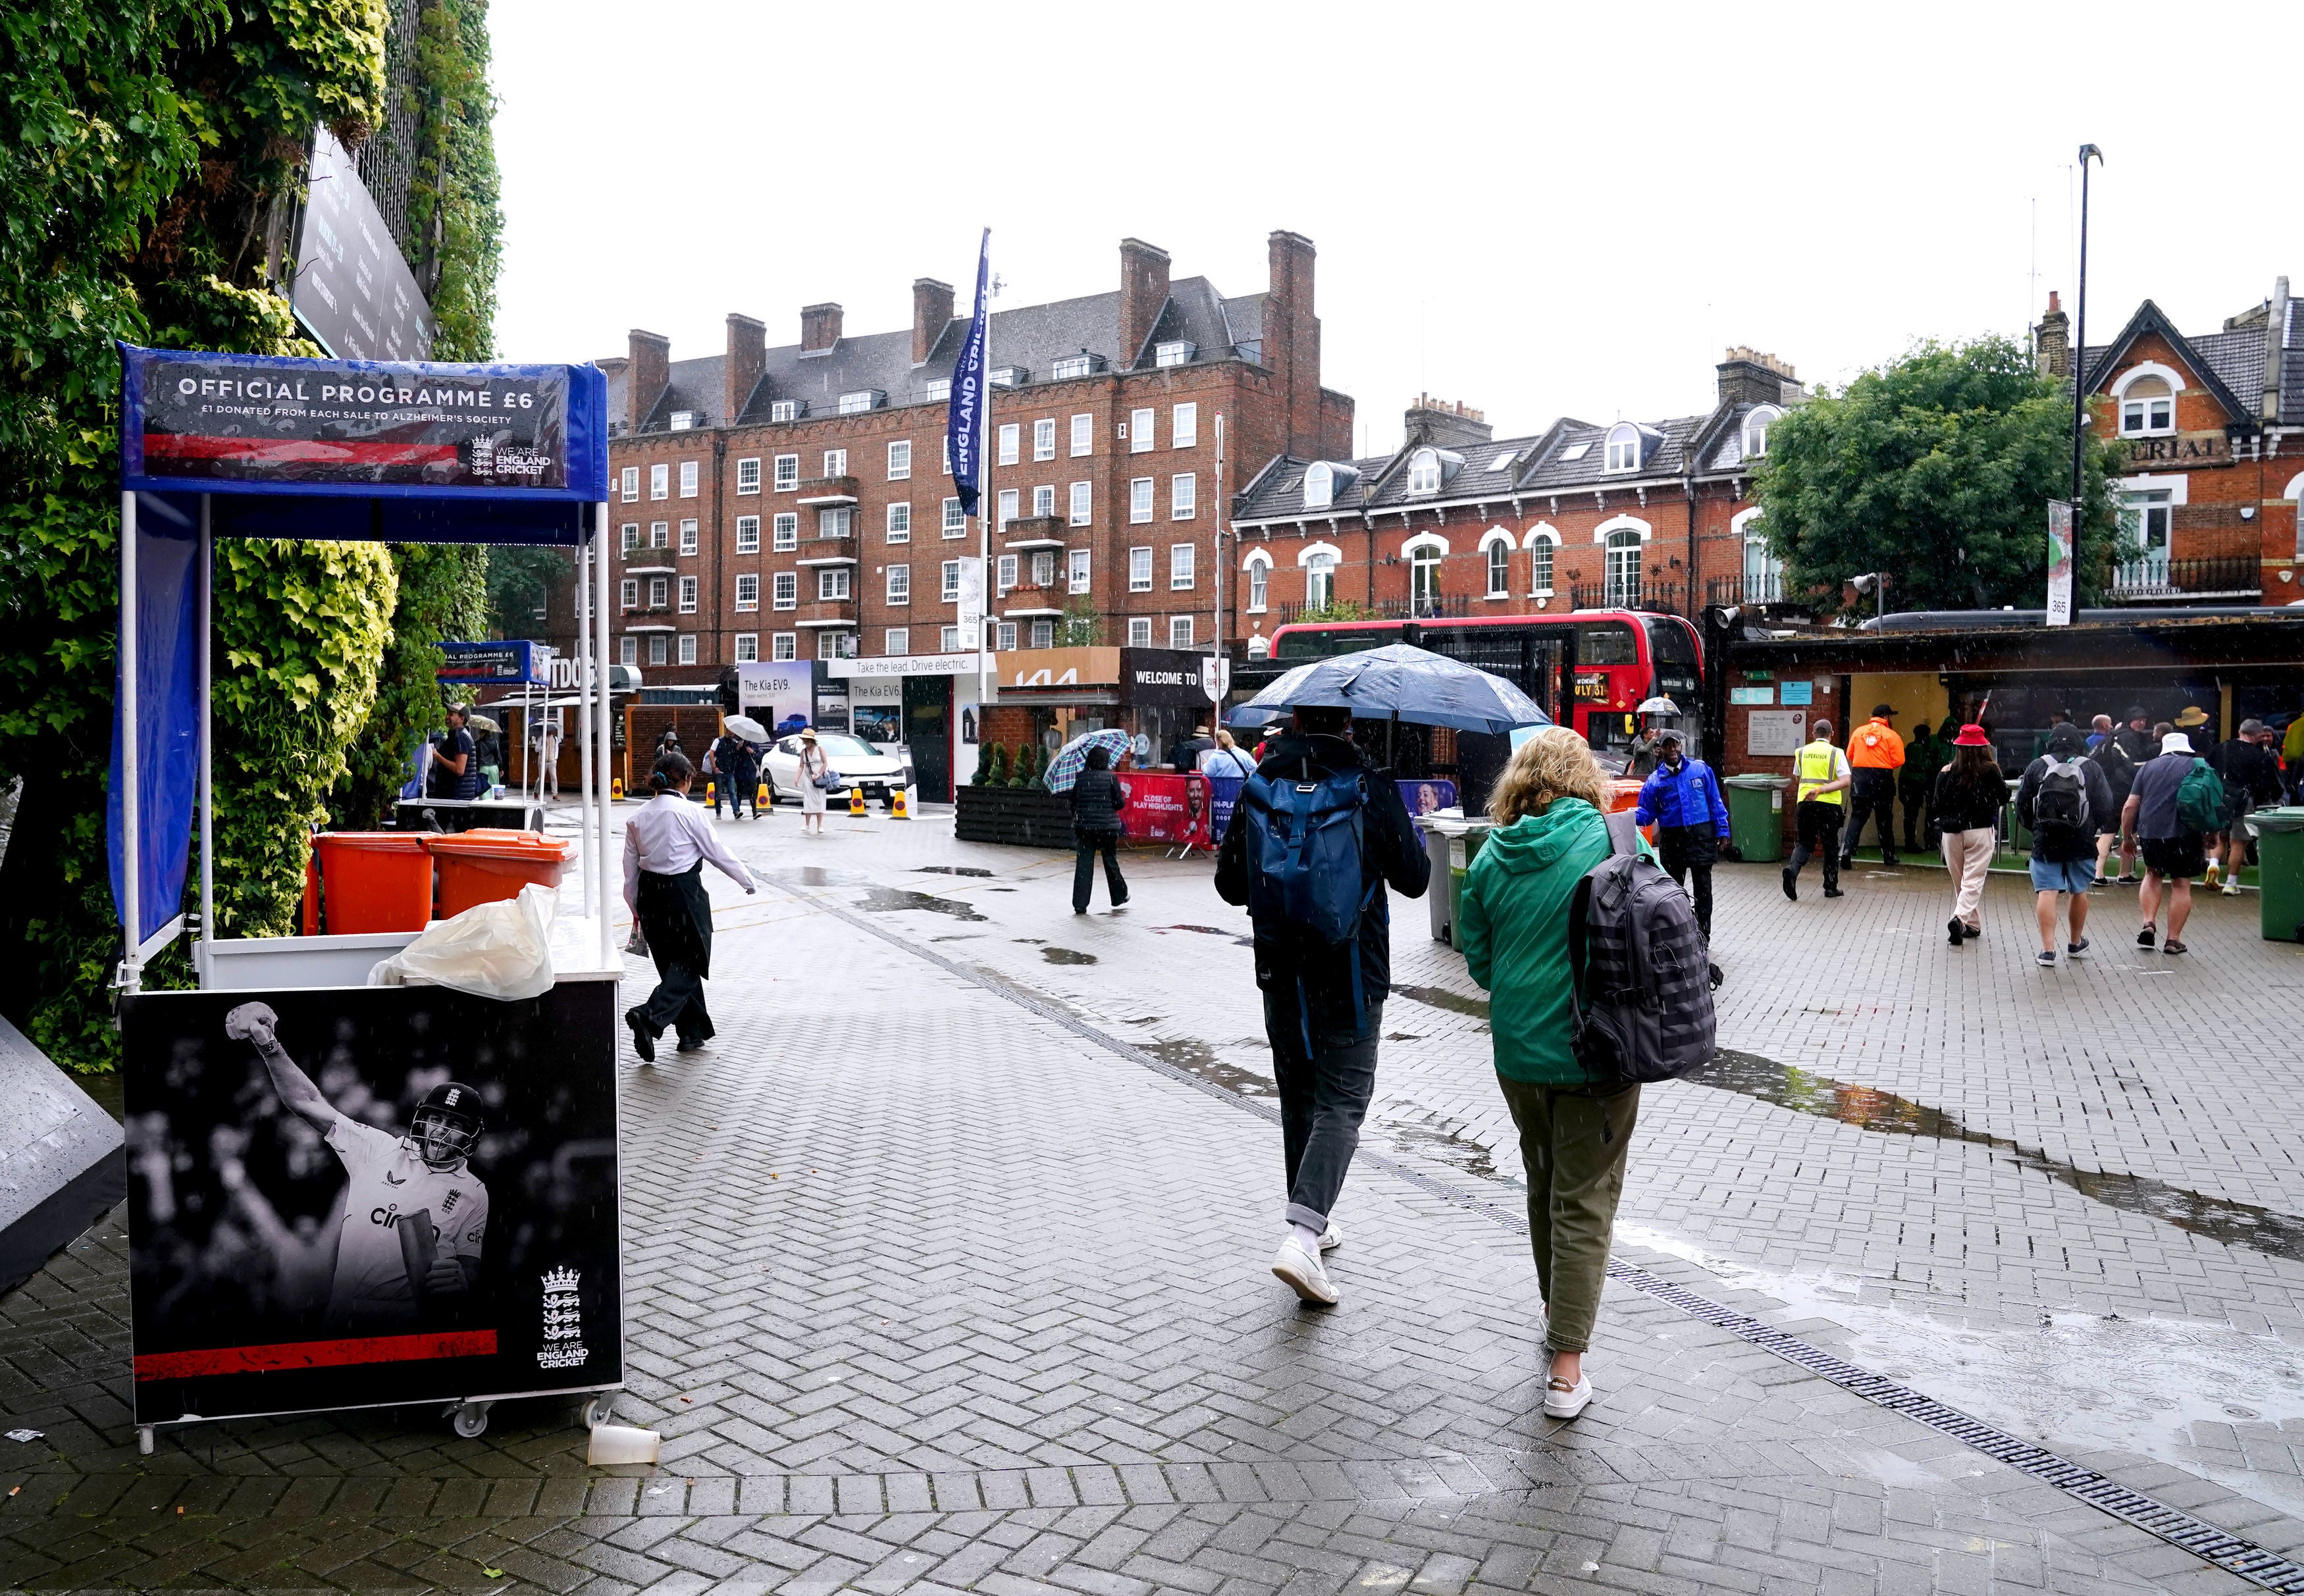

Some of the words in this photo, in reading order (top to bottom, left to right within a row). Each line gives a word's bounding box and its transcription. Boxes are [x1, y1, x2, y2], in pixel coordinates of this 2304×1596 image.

[178, 378, 309, 401] OFFICIAL
[322, 385, 492, 407] PROGRAMME
[503, 392, 533, 409] £6
[217, 405, 271, 415] DONATED
[275, 408, 307, 417] FROM
[310, 410, 340, 419] EACH
[392, 413, 463, 423] ALZHEIMER'S
[466, 415, 511, 425] SOCIETY
[958, 376, 976, 475] ENGLAND
[496, 447, 514, 455] WE
[517, 448, 539, 456] ARE
[496, 455, 551, 466] ENGLAND
[496, 465, 544, 475] CRICKET
[2052, 600, 2066, 613] 365
[963, 615, 978, 624] 365
[550, 647, 560, 657] OG!
[856, 662, 874, 673] Take
[876, 662, 889, 673] the
[891, 661, 910, 672] lead.
[912, 659, 933, 671] Drive
[935, 657, 968, 670] electric.
[1136, 670, 1182, 686] WELCOME
[1184, 673, 1197, 686] TO
[1206, 678, 1226, 686] SUREY
[745, 680, 758, 691] The
[760, 679, 772, 690] Kia
[773, 679, 791, 690] EV9.
[854, 686, 868, 697] The
[870, 686, 881, 697] Kia
[884, 685, 901, 696] EV6.
[1575, 684, 1591, 696] ULY
[1594, 684, 1604, 696] 31
[1148, 802, 1183, 811] HIGHLIGHTS
[542, 1343, 560, 1352] WE
[562, 1341, 583, 1351] ARE
[537, 1348, 589, 1361] ENGLAND
[540, 1356, 586, 1369] CRICKET
